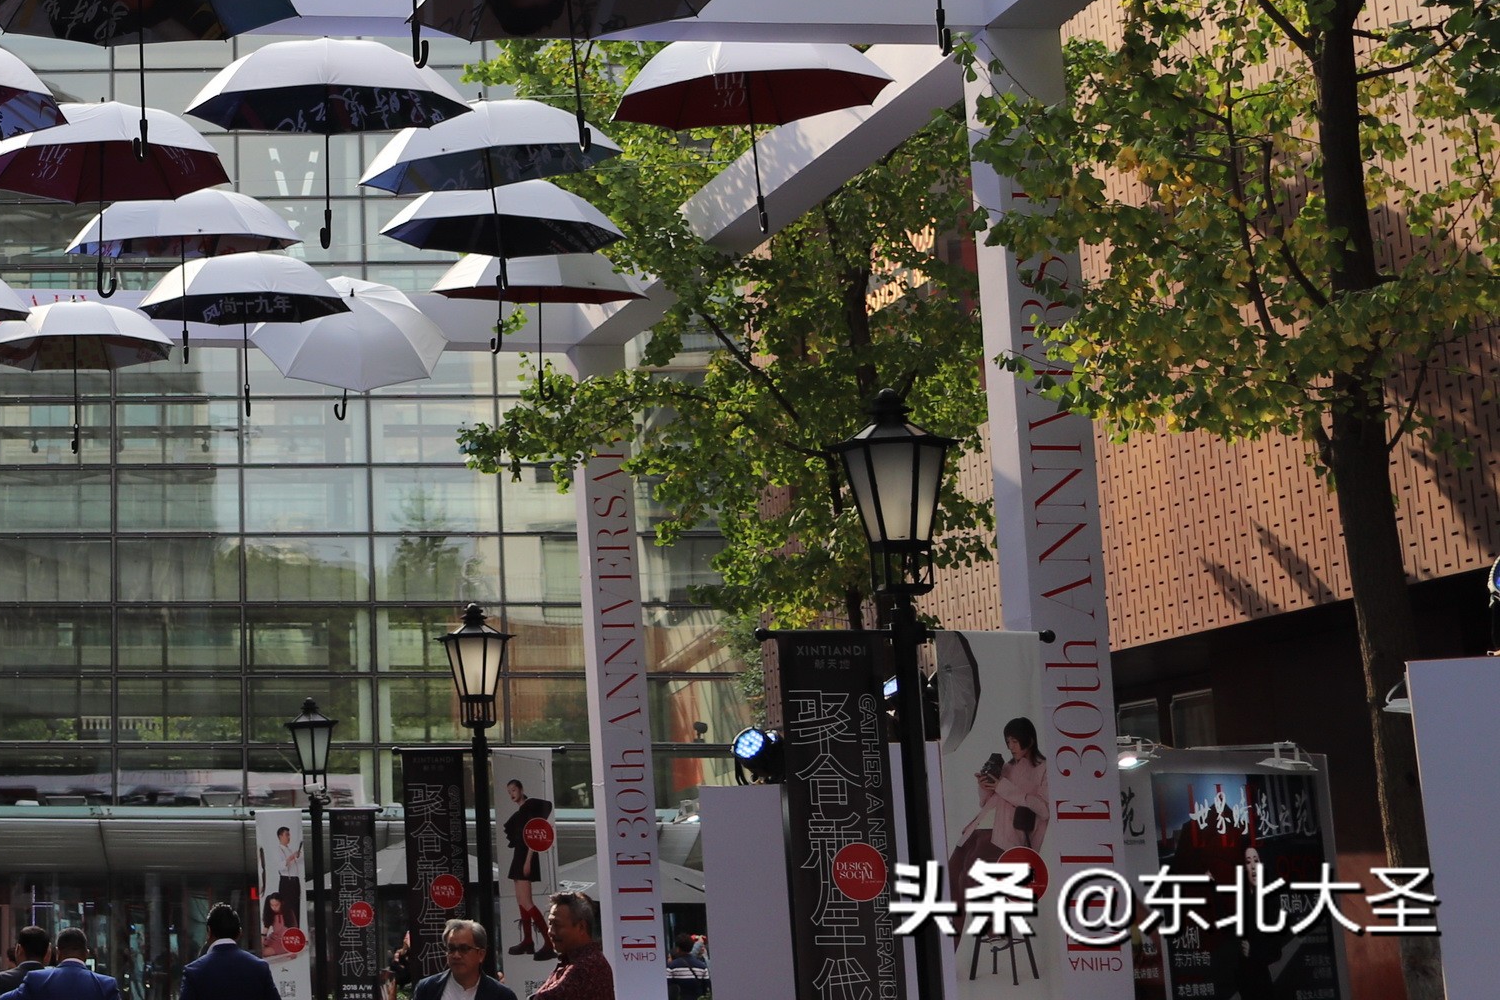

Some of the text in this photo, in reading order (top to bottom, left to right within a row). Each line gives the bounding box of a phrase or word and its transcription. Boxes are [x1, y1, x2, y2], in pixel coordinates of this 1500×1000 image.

[31, 163, 60, 180] 30
[202, 293, 294, 322] 风尚十九年
[796, 645, 867, 657] XINTIANDI
[1045, 637, 1105, 779] 30th
[858, 693, 882, 789] GATHER
[611, 750, 649, 839] 30th
[864, 791, 884, 813] A
[837, 862, 873, 872] DESIGN
[839, 869, 875, 884] SOCIAL
[616, 850, 658, 950] ELLE
[623, 951, 658, 963] CHINA
[1069, 956, 1123, 972] CHINA
[1174, 951, 1211, 968] 东方传奇
